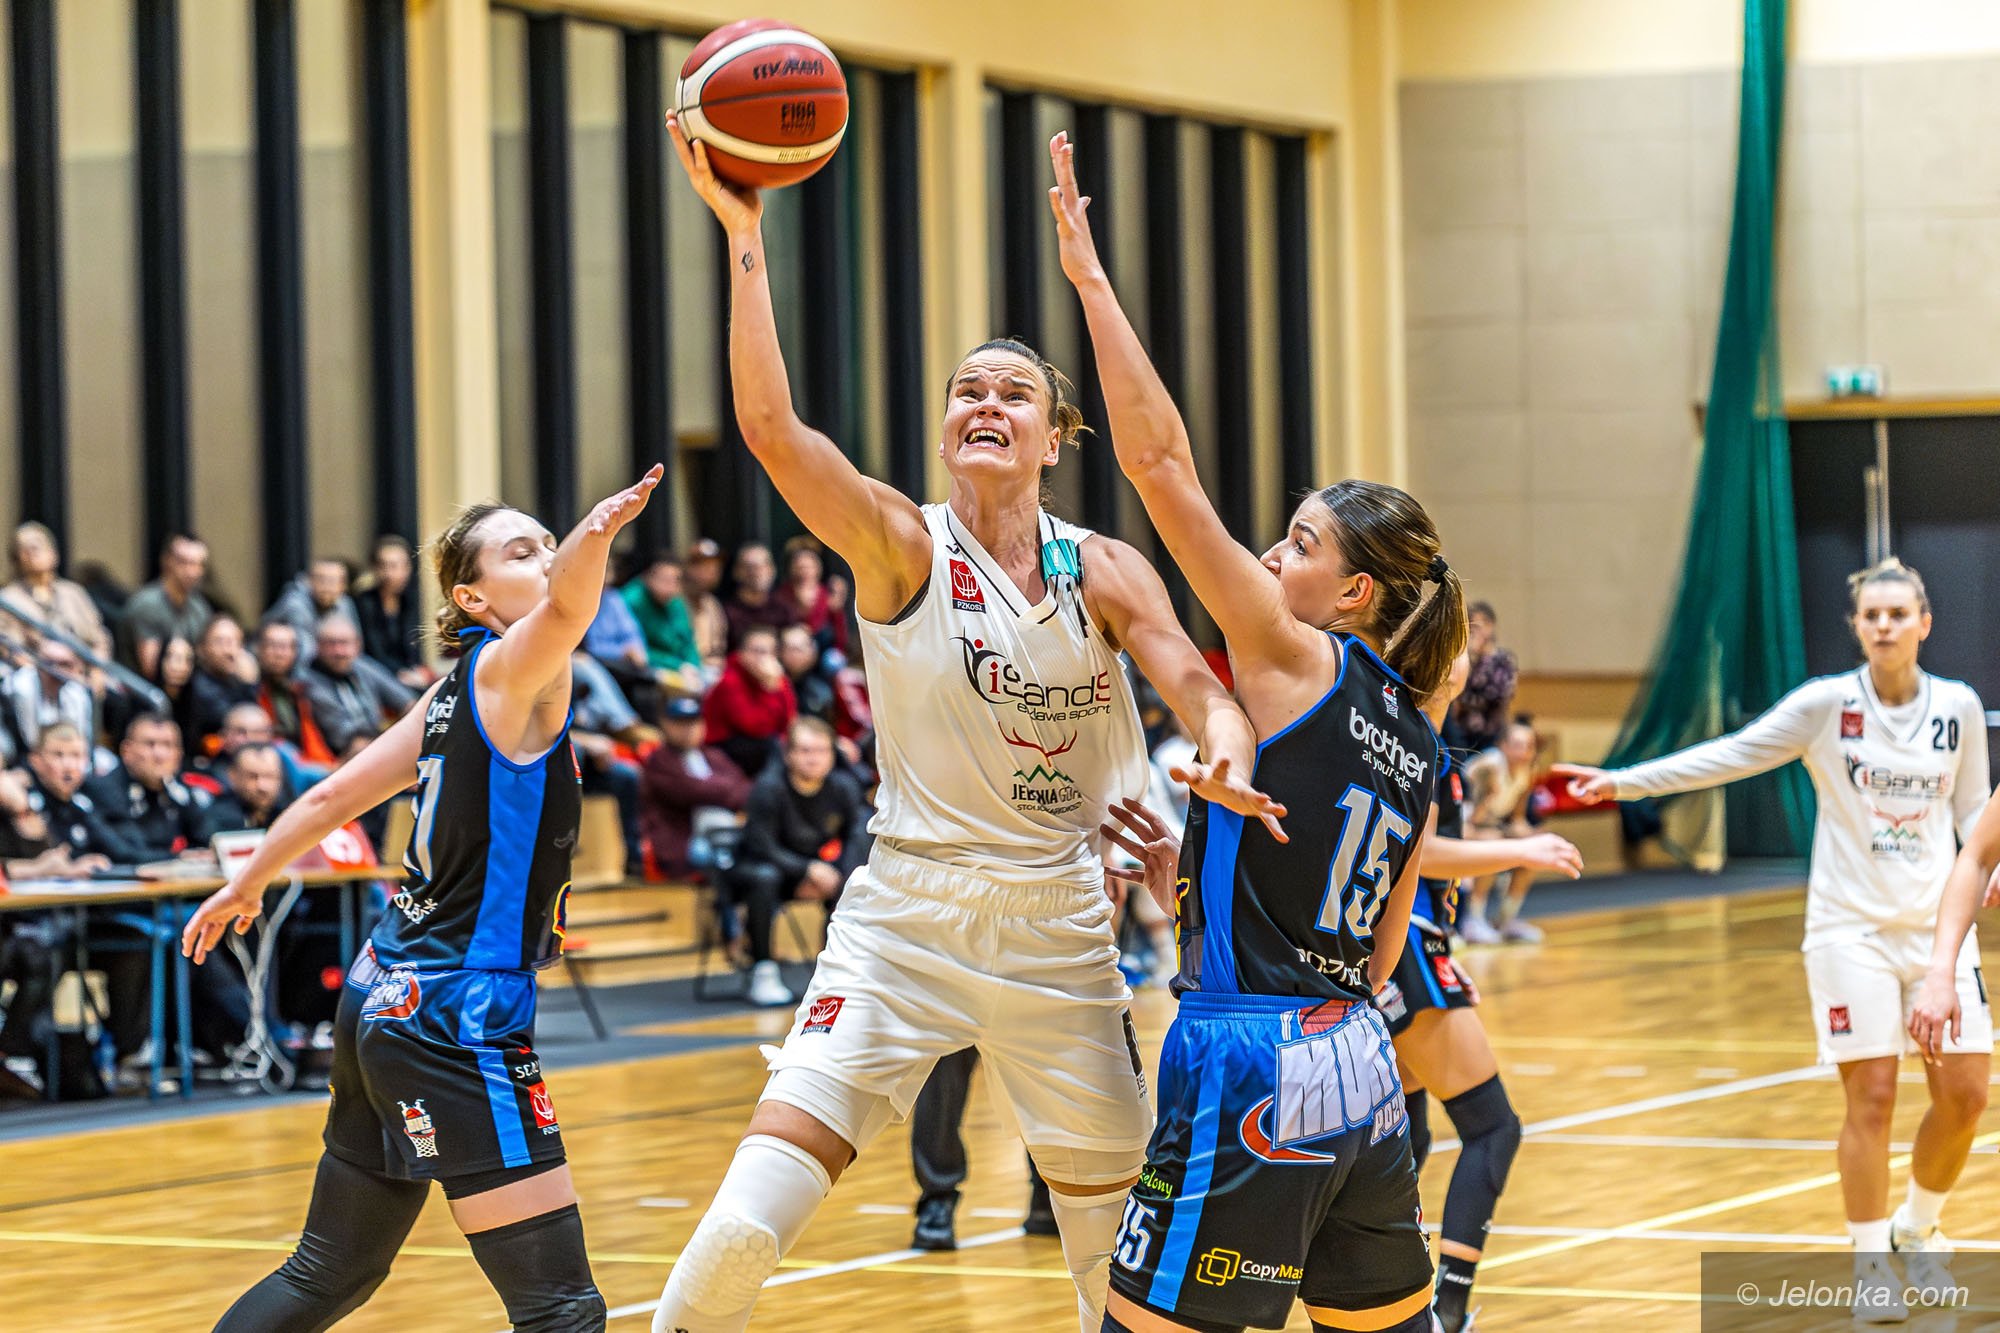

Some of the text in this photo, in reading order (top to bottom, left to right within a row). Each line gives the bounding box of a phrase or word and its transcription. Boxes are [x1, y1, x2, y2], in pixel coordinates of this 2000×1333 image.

[1069, 704, 1111, 721] sport
[1349, 706, 1428, 783] brother
[1931, 717, 1960, 752] 20
[1362, 750, 1372, 764] at
[1372, 756, 1395, 777] your
[1314, 782, 1412, 941] 15
